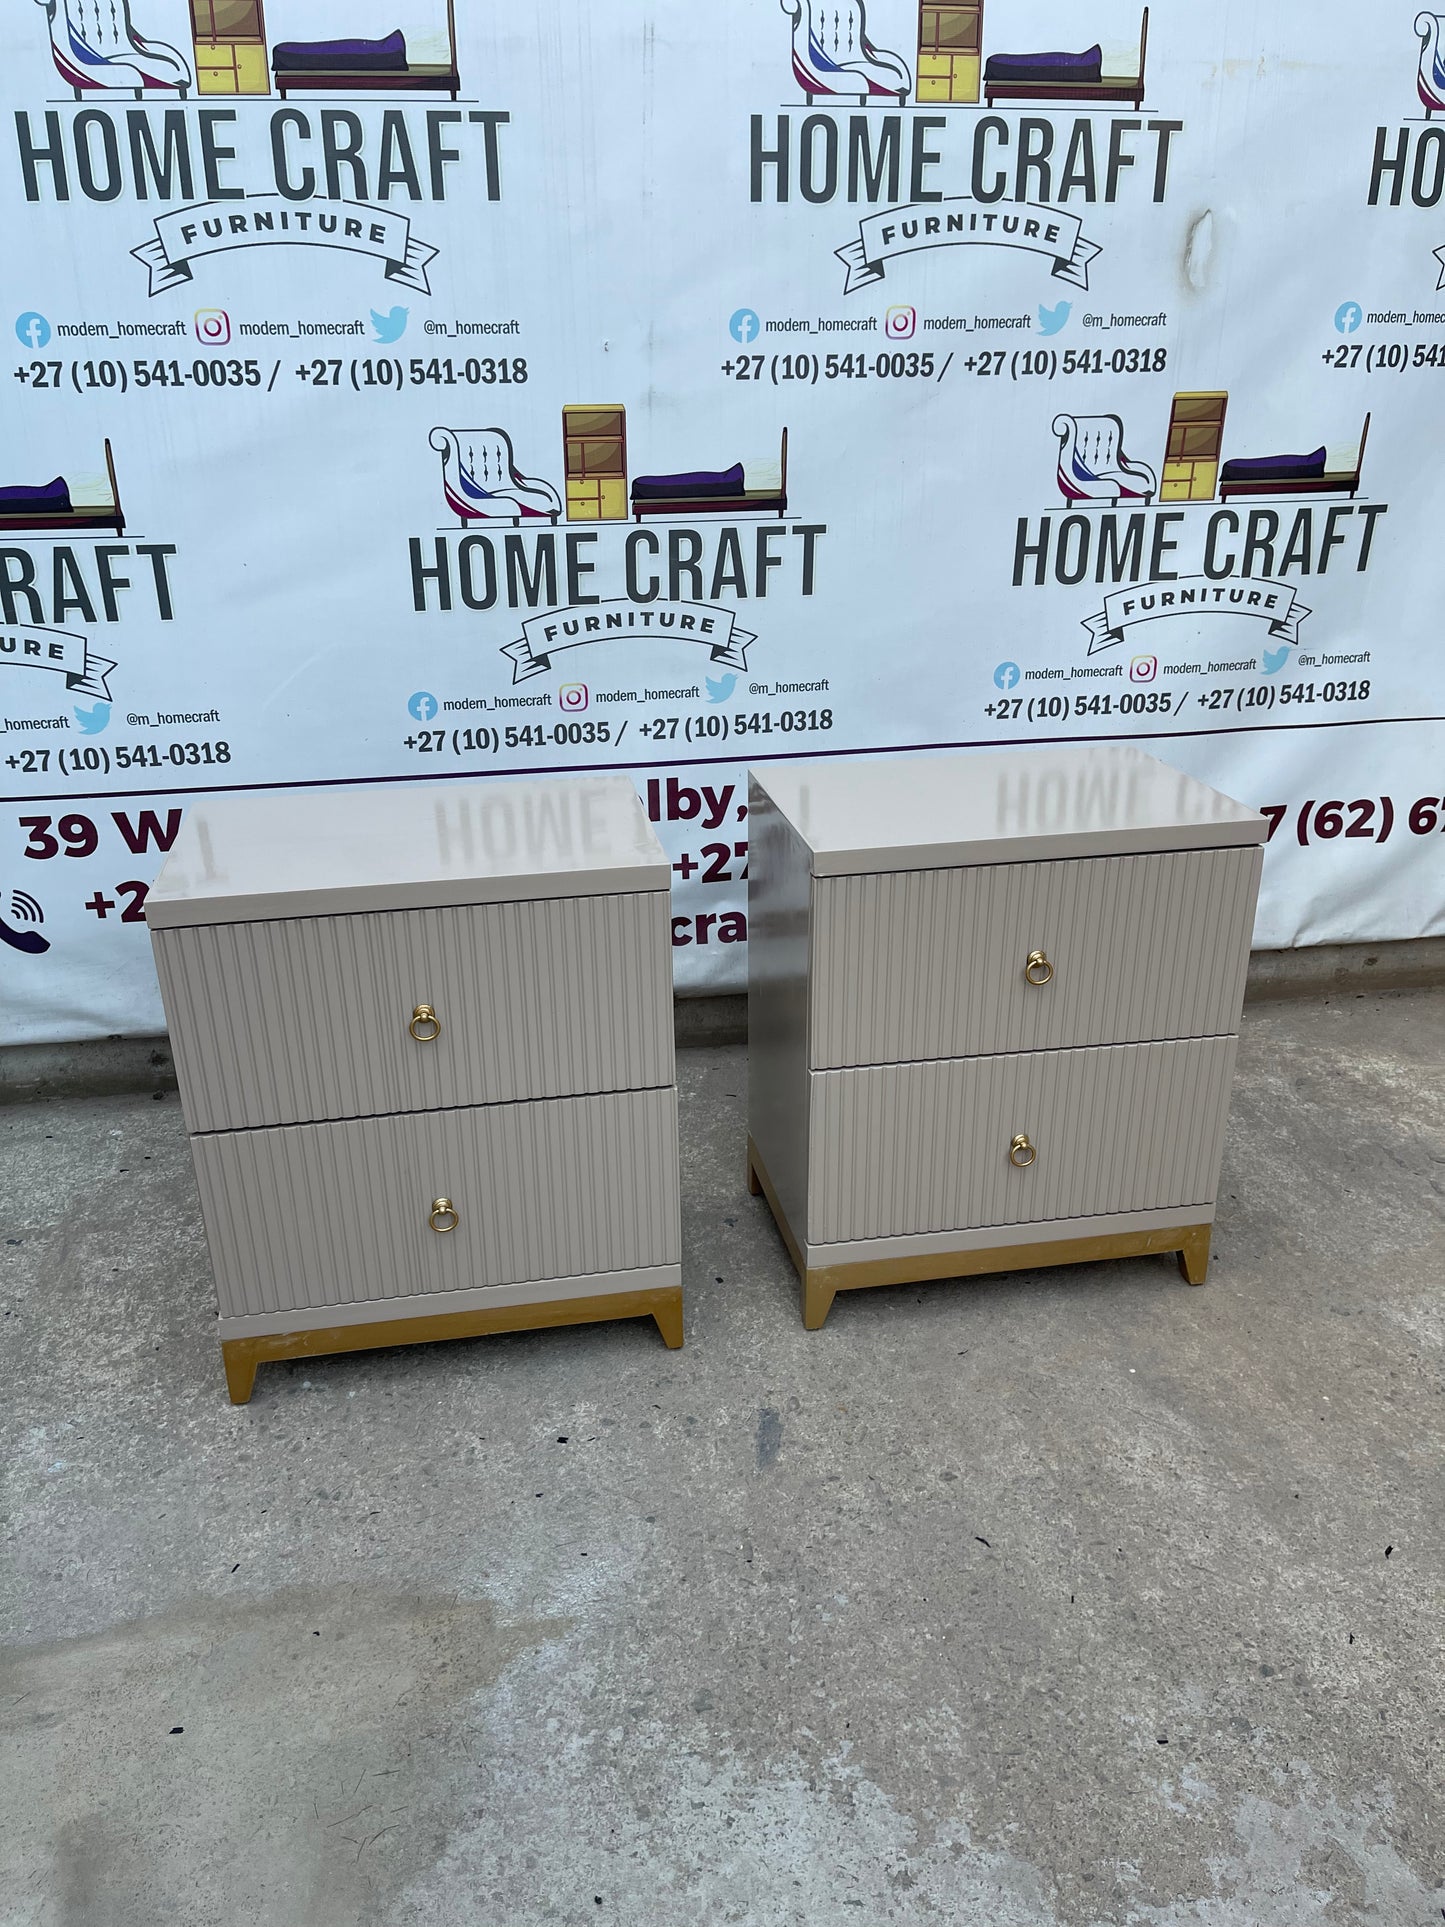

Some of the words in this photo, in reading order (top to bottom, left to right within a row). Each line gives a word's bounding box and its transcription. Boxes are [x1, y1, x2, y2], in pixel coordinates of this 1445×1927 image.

[14, 109, 247, 202] HOME
[269, 107, 511, 202] CRAFT
[750, 113, 947, 203] HOME
[971, 116, 1184, 204] CRAFT
[180, 211, 387, 246] FURNITURE
[880, 212, 1062, 246] FURNITURE
[58, 321, 186, 338] modern_homecraft
[240, 320, 365, 338] modern_homecraft
[424, 320, 520, 337] @m_homecraft
[766, 317, 877, 334] modern_homecraft
[924, 315, 1031, 332] modern_homecraft
[1083, 313, 1166, 329] @m_homecraft
[14, 362, 62, 387] +27
[72, 361, 127, 393] (10)
[134, 360, 260, 387] 541-0035
[296, 360, 342, 385] +27
[351, 359, 403, 391] (10)
[410, 358, 527, 384] 541-0318
[722, 355, 765, 380] +27
[771, 355, 818, 385] (10)
[825, 353, 934, 378] 541-0035
[965, 352, 1006, 375] +27
[1011, 351, 1056, 380] (10)
[1063, 348, 1166, 374] 541-0318
[1322, 345, 1362, 368] +27
[1367, 345, 1408, 373] (10)
[1012, 510, 1186, 587] HOME
[1203, 504, 1388, 580] CRAFT
[408, 531, 602, 612] HOME
[624, 523, 827, 603] CRAFT
[1122, 587, 1279, 616] FURNITURE
[543, 610, 716, 642] FURNITURE
[1025, 665, 1123, 680] modern_homecraft
[1164, 659, 1256, 674] modern_homecraft
[1298, 651, 1370, 667] @m_homecraft
[444, 694, 551, 710] modern_homecraft
[596, 686, 699, 702] modern_homecraft
[749, 679, 829, 695] @m_homecraft
[985, 699, 1023, 719] +27
[1028, 697, 1069, 722] (10)
[1075, 693, 1171, 715] 541-0035
[1198, 689, 1234, 709] +27
[1237, 686, 1275, 711] (10)
[1280, 680, 1370, 704] 541-0318
[127, 710, 220, 727] @m_homecraft
[404, 731, 445, 752] +27
[453, 728, 499, 755] (10)
[505, 722, 610, 747] 541-0035
[640, 718, 679, 739] +27
[685, 716, 728, 742] (10)
[734, 709, 832, 734] 541-0318
[5, 750, 50, 772] +27
[59, 748, 109, 776] (10)
[116, 742, 230, 768] 541-0318
[19, 814, 98, 859] 39
[1297, 797, 1393, 846] (62)
